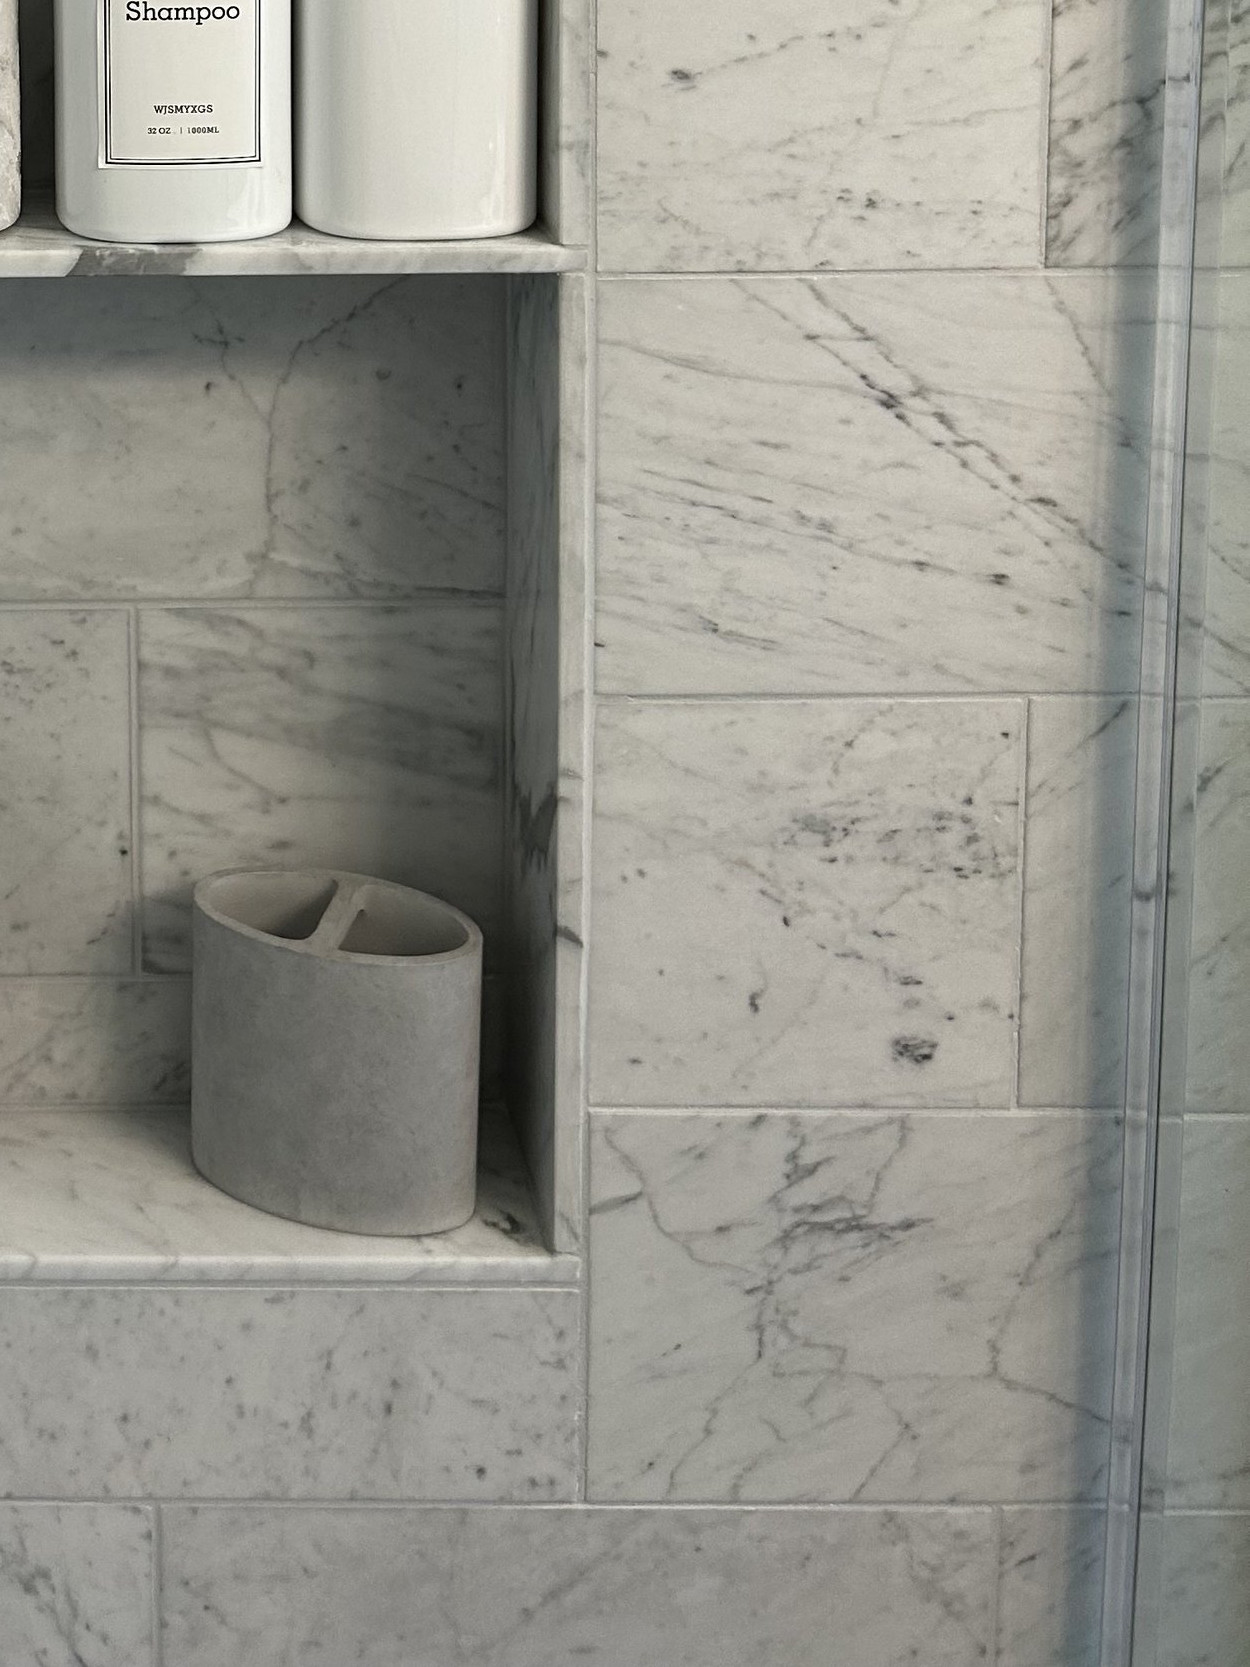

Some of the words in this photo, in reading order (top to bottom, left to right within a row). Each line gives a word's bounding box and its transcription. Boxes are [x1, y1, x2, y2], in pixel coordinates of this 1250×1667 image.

[125, 0, 240, 26] Shampoo
[153, 104, 214, 115] WJSMYXGS
[147, 127, 157, 135] 32
[187, 126, 220, 134] 1000ML
